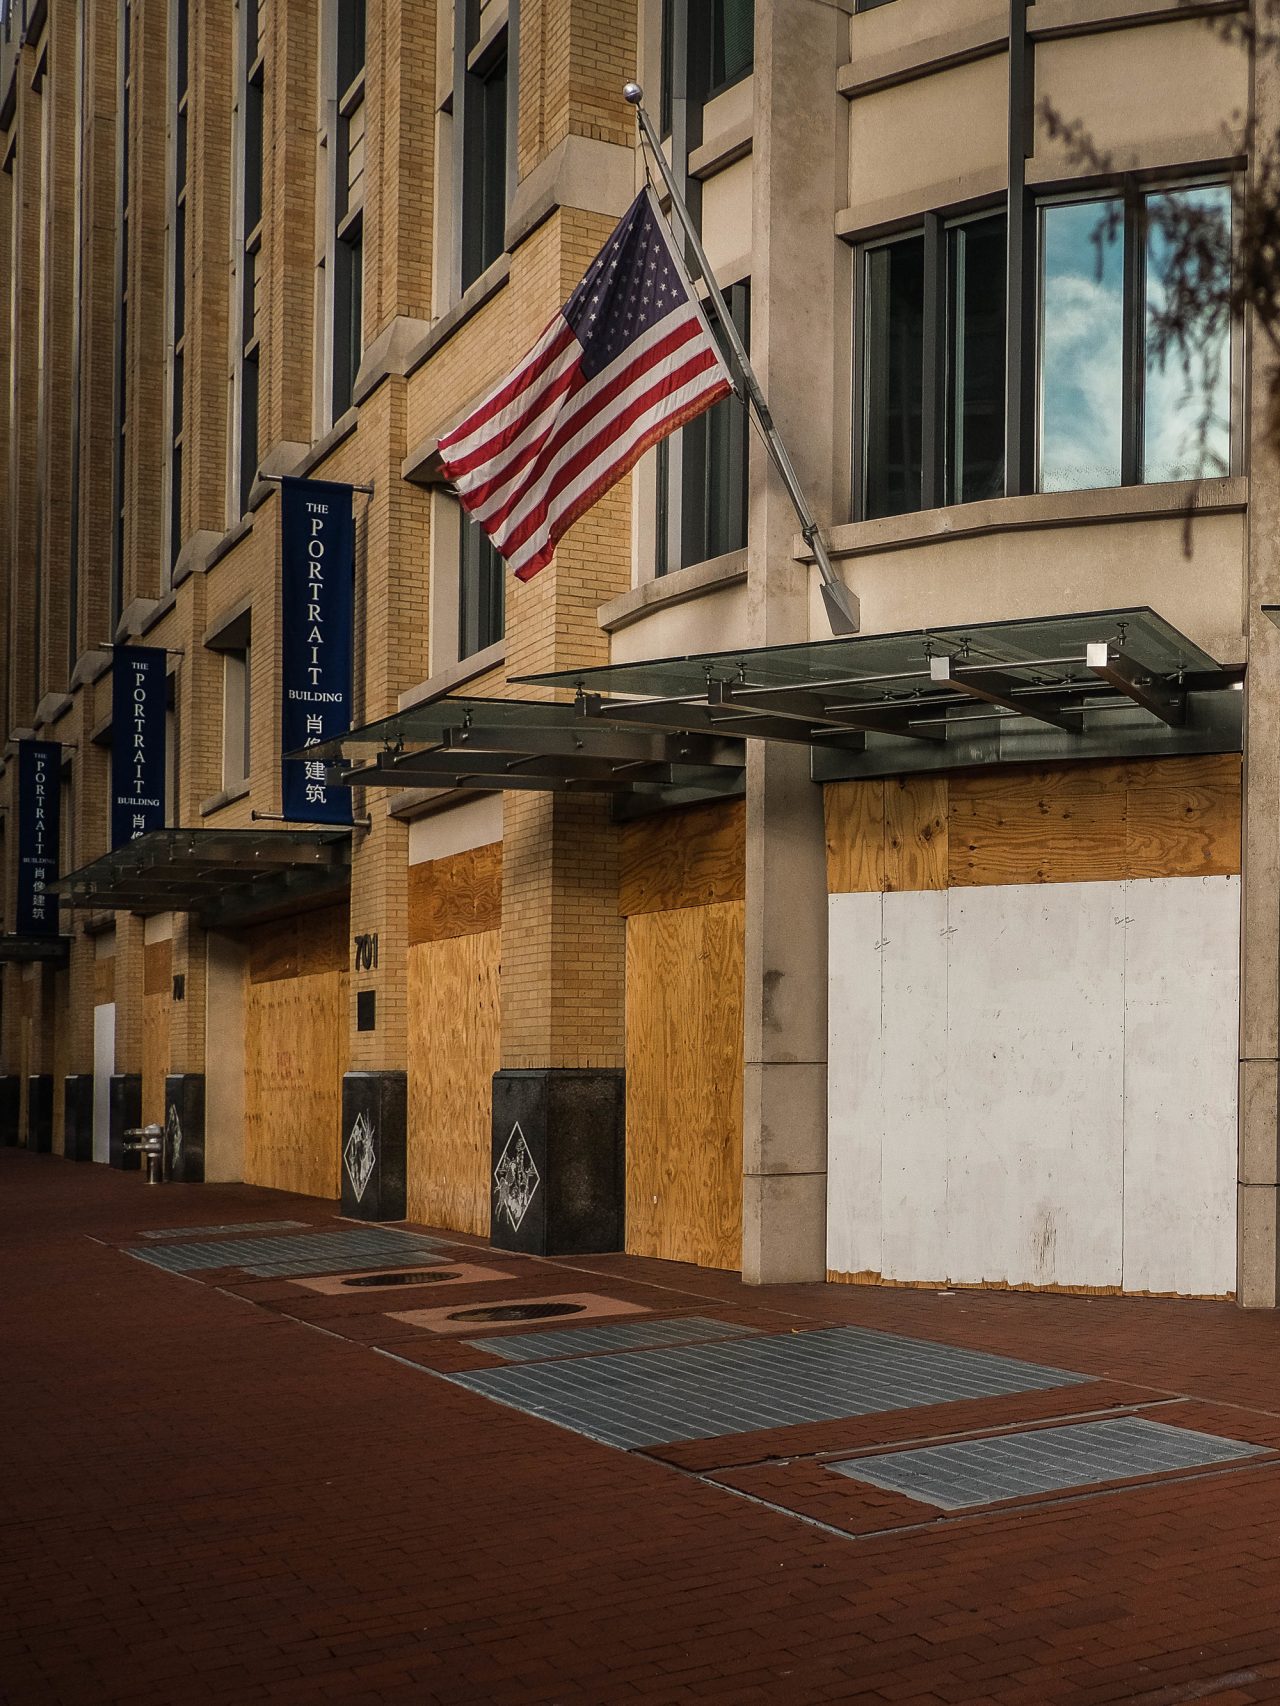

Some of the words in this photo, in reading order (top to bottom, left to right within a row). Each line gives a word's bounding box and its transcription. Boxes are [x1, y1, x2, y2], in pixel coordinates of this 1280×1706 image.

[305, 502, 329, 514] THE
[306, 518, 325, 685] PORTRAIT
[131, 661, 149, 671] THE
[288, 689, 343, 702] BUILDING
[133, 673, 146, 793] PORTRAIT
[35, 760, 46, 855] PORTRAIT
[117, 796, 160, 806] BUILDING
[354, 932, 379, 972] 701
